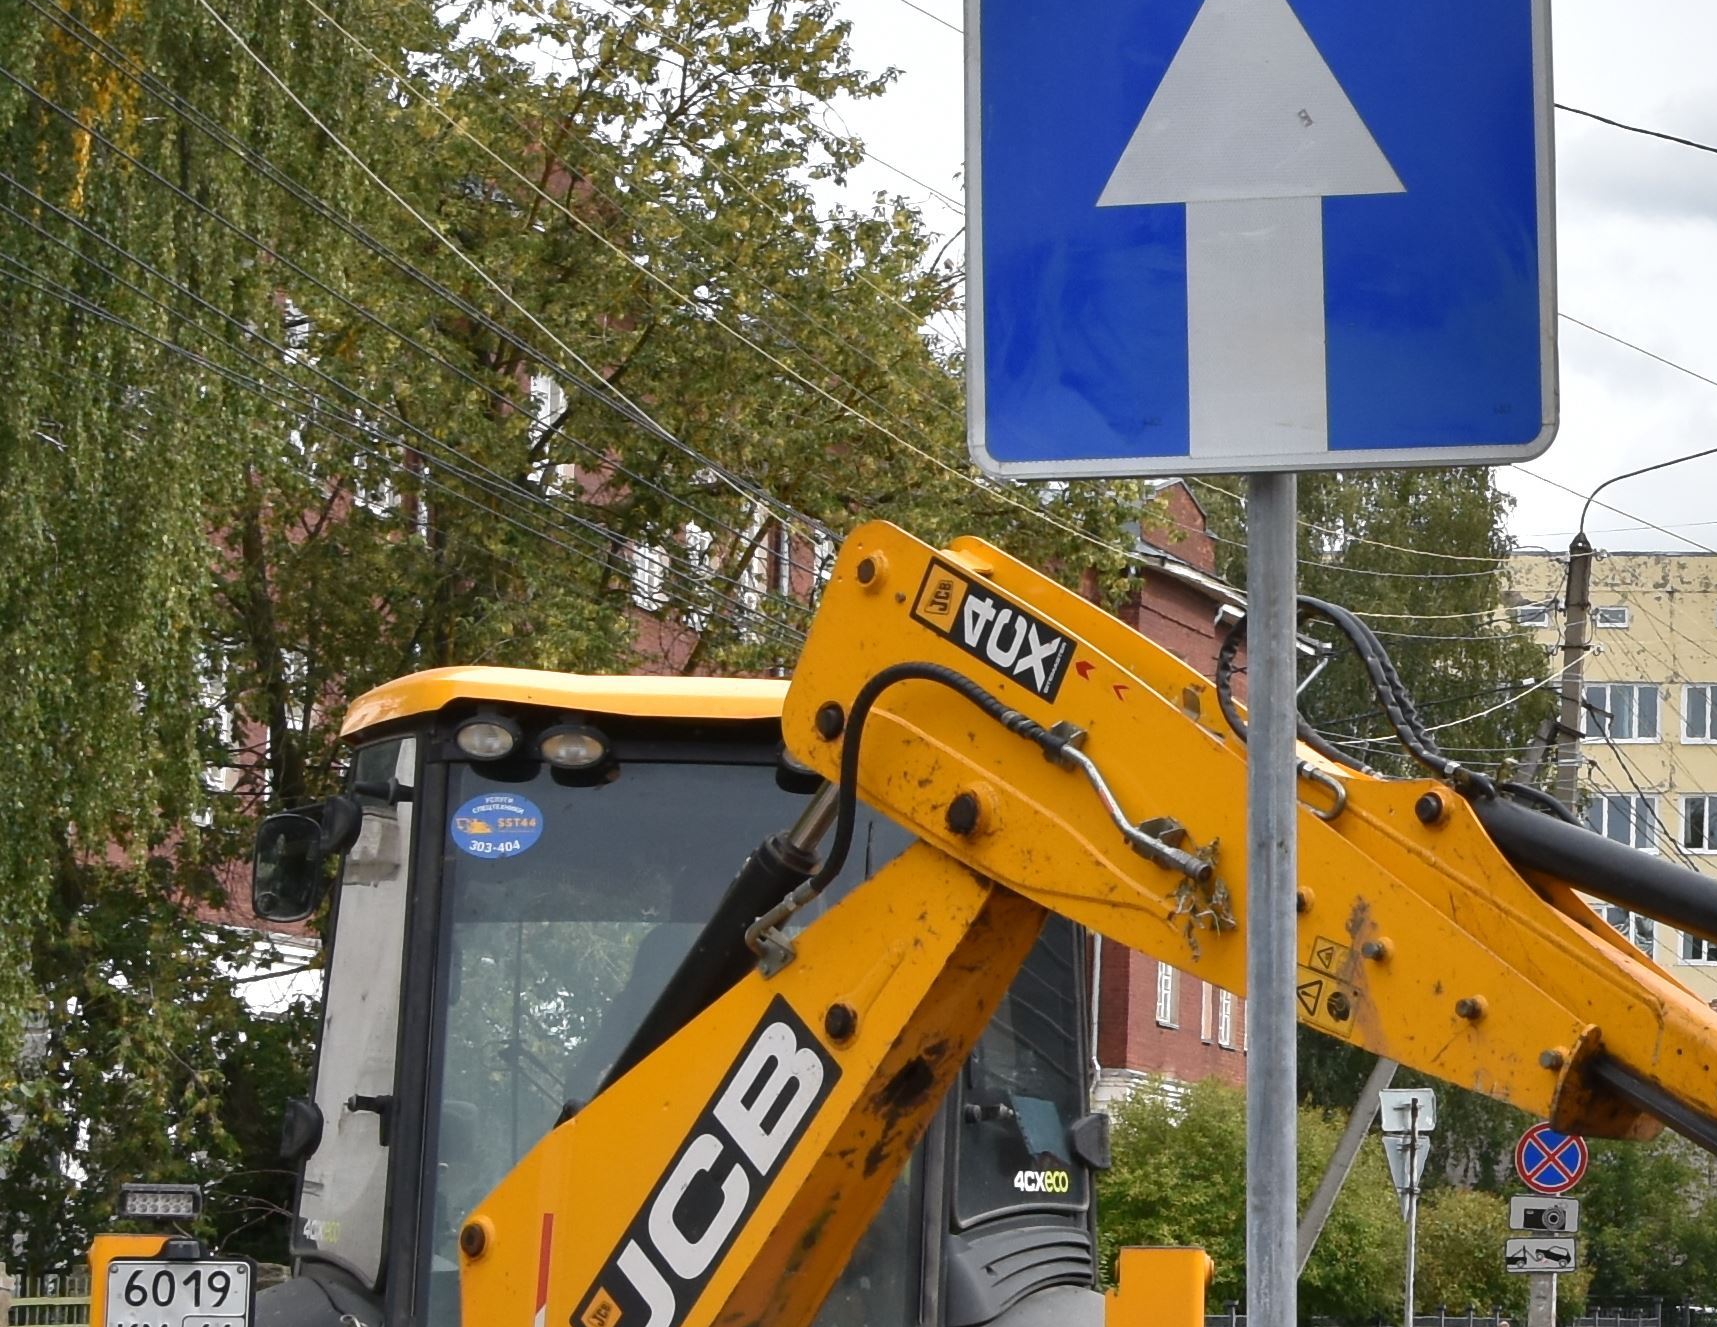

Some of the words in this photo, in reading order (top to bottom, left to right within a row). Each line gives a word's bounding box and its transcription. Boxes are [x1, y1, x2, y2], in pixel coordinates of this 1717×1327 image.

[932, 580, 953, 612] JCB
[963, 594, 1062, 693] 4CX
[497, 818, 537, 828] SST44
[469, 839, 521, 853] 303-404
[124, 1269, 231, 1308] 6019
